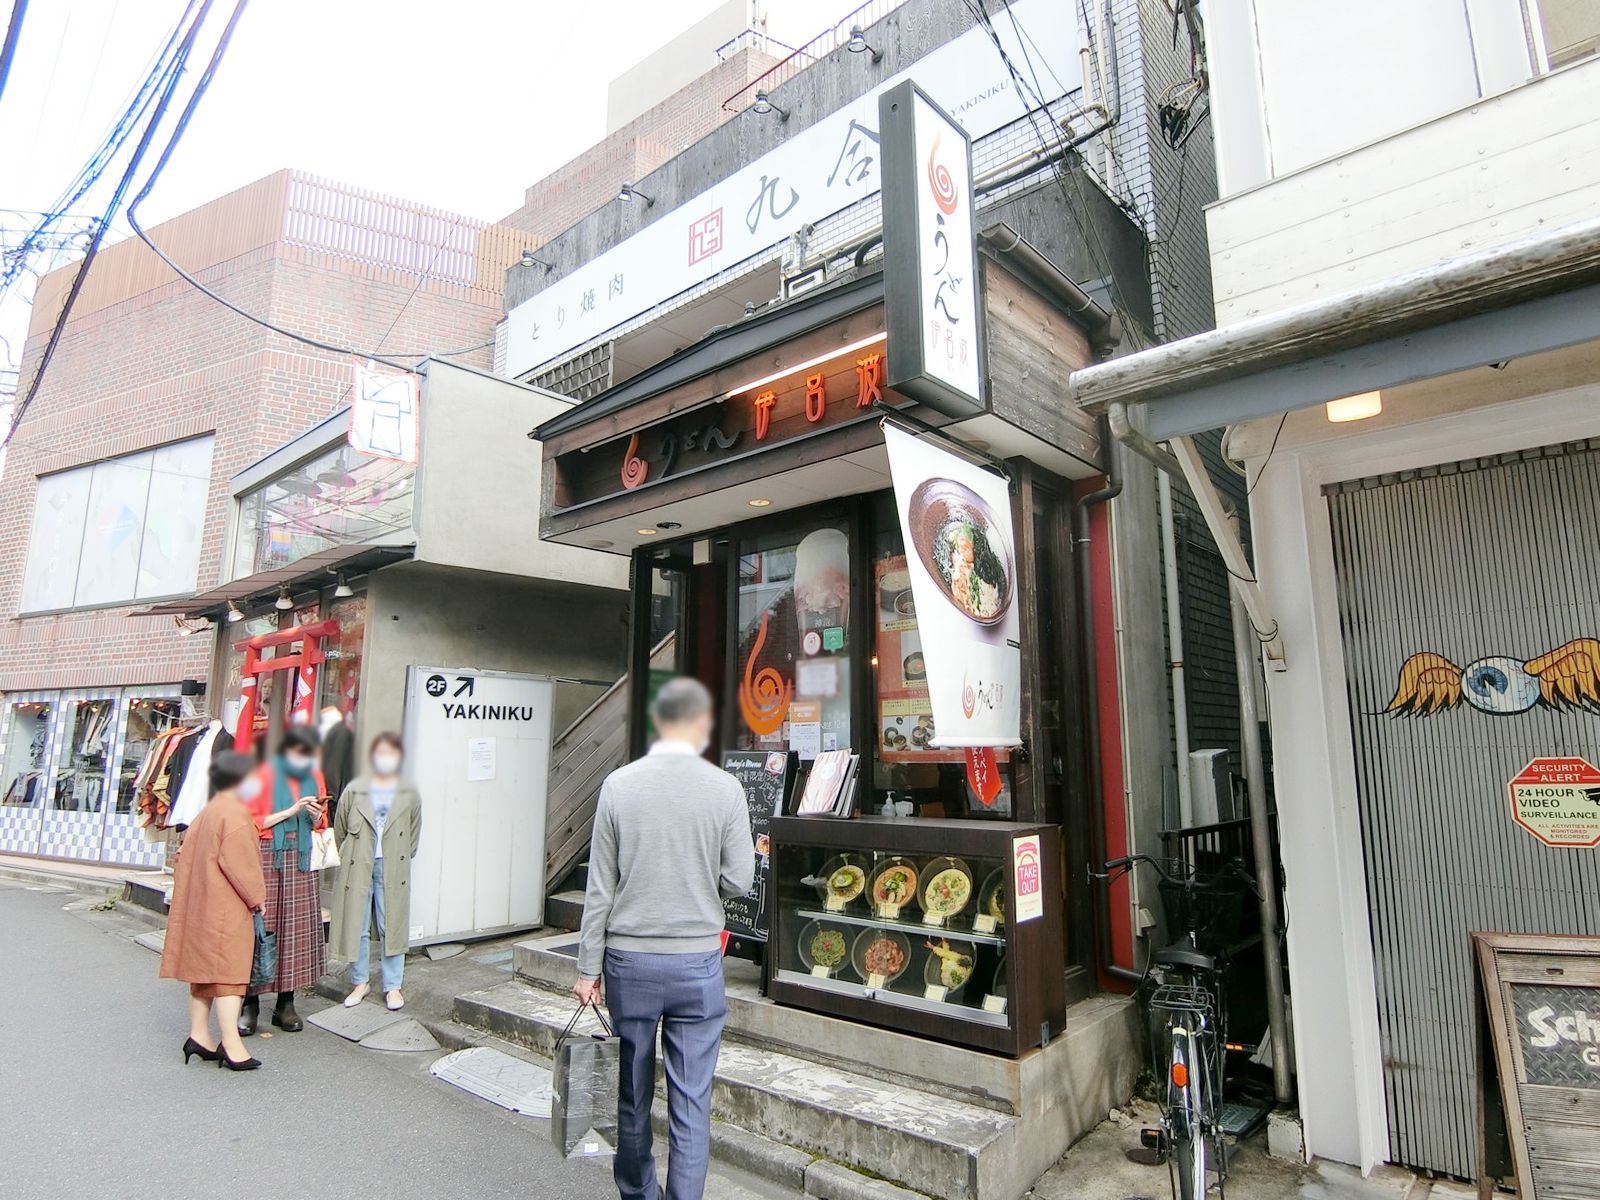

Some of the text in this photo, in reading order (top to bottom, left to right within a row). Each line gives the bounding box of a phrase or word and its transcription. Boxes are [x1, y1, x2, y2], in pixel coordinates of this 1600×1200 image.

[950, 78, 1009, 117] YAKINIKU
[531, 272, 625, 341] とり焼肉
[428, 679, 445, 693] 2F
[443, 703, 533, 721] YAKINIKU
[1532, 764, 1586, 772] SECURITY
[1540, 773, 1580, 782] ALERT
[1517, 788, 1575, 797] 24 HOUR
[1519, 799, 1560, 808] VIDEO
[1520, 811, 1598, 819] SURVEILLANCE
[1019, 865, 1037, 880] TAKE
[1021, 879, 1036, 894] OUT
